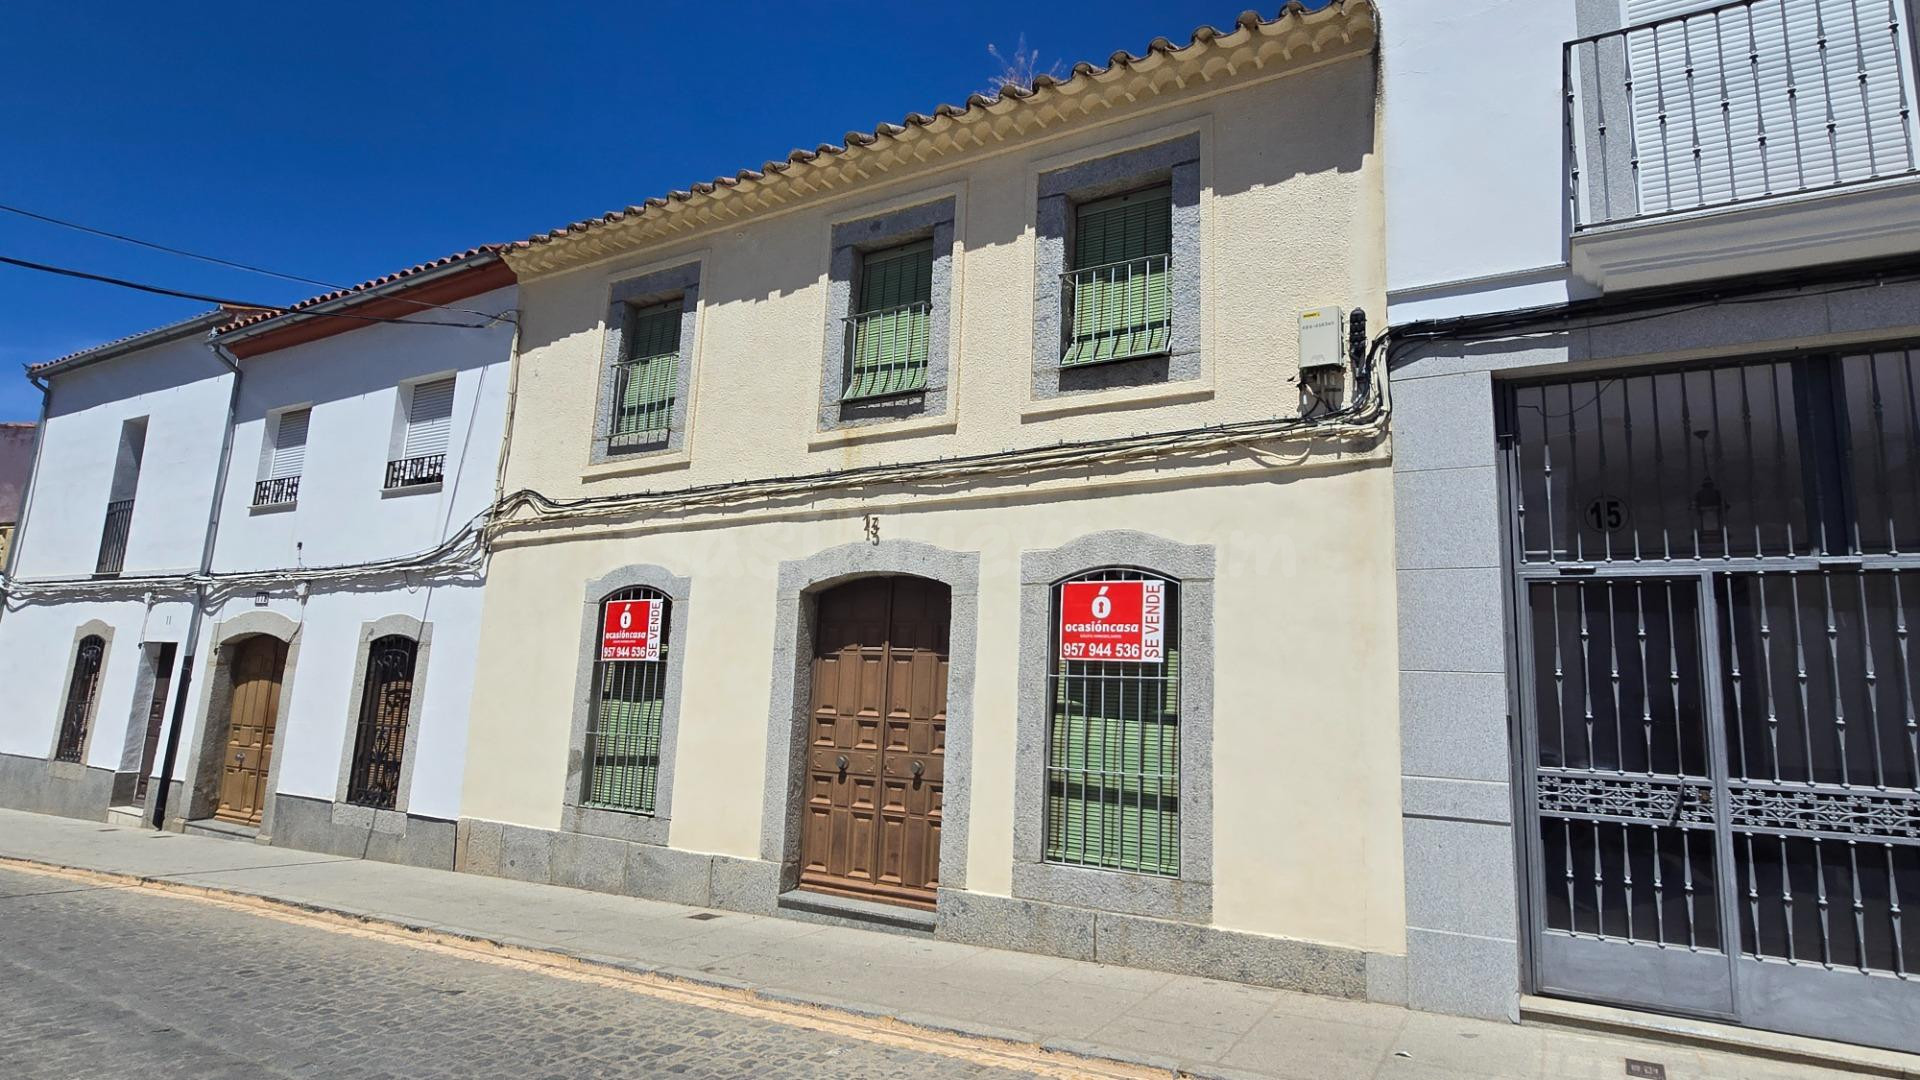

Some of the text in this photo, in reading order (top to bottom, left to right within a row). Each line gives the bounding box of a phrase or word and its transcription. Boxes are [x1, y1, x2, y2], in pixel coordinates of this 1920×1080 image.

[1590, 501, 1622, 529] 15
[1065, 620, 1139, 633] ocasióncasa
[1144, 584, 1160, 658] SE VENDE
[605, 630, 647, 640] ocasióncasa
[647, 602, 660, 657] SE VENDE
[603, 646, 646, 658] 957 944 536
[1063, 643, 1140, 657] 957 944 536
